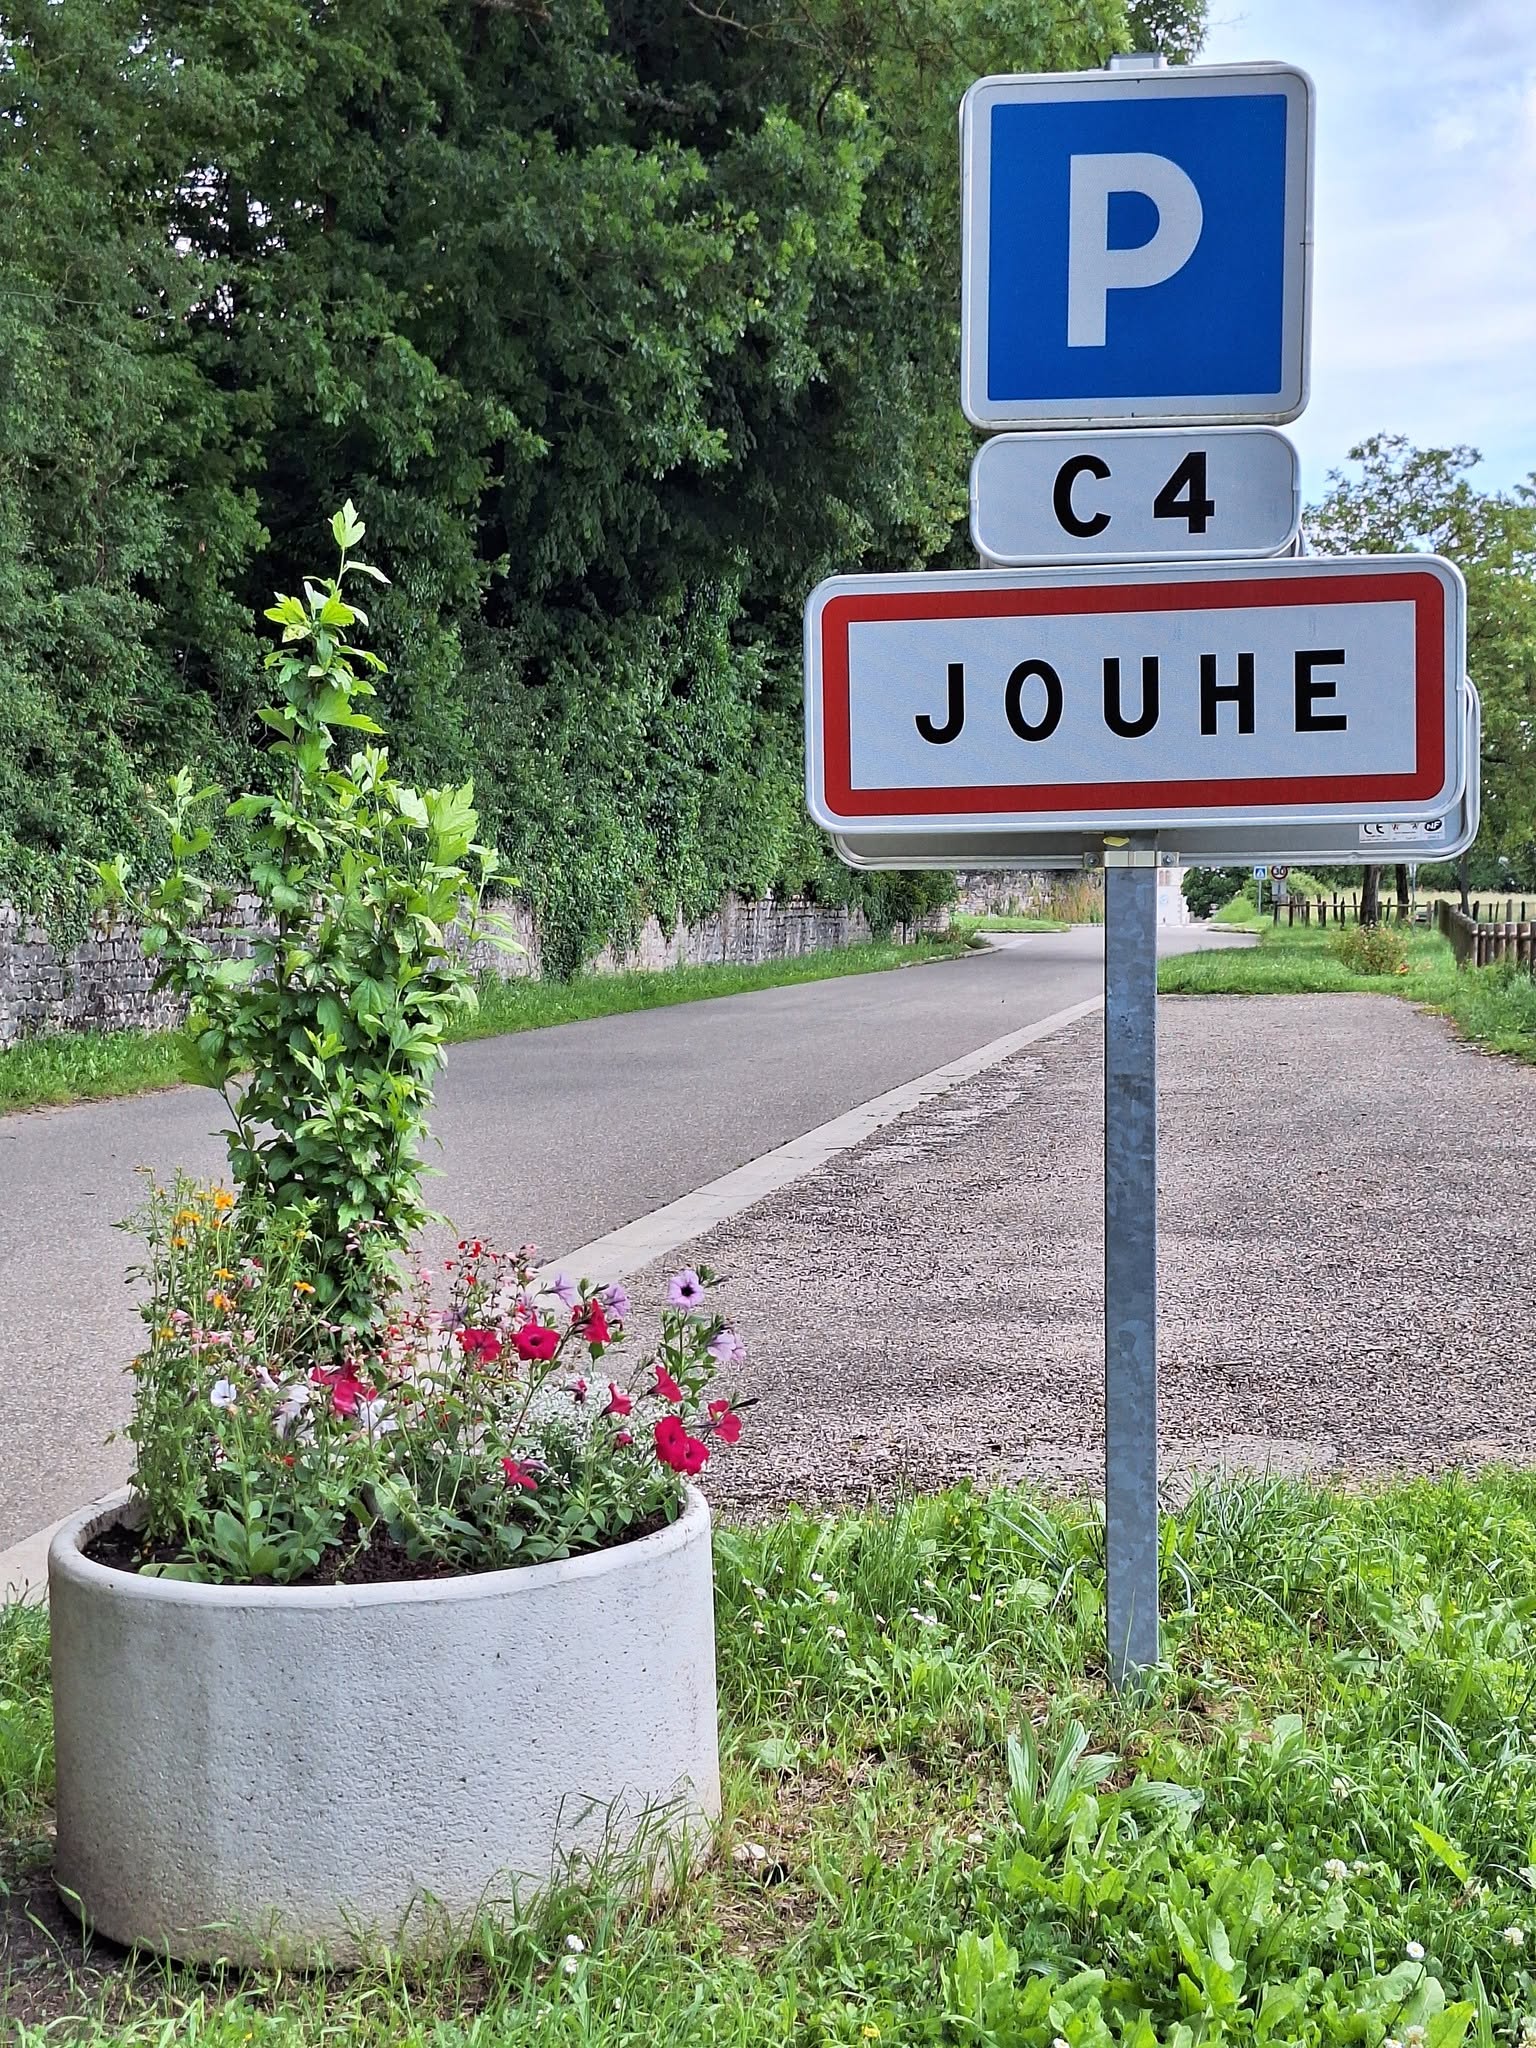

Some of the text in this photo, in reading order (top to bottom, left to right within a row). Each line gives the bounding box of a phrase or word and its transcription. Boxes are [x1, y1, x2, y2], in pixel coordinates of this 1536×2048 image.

[1068, 153, 1203, 347] P
[915, 649, 1348, 746] JOUHE
[1363, 823, 1385, 835] CE
[1425, 820, 1442, 830] NF
[1273, 866, 1286, 876] 30
